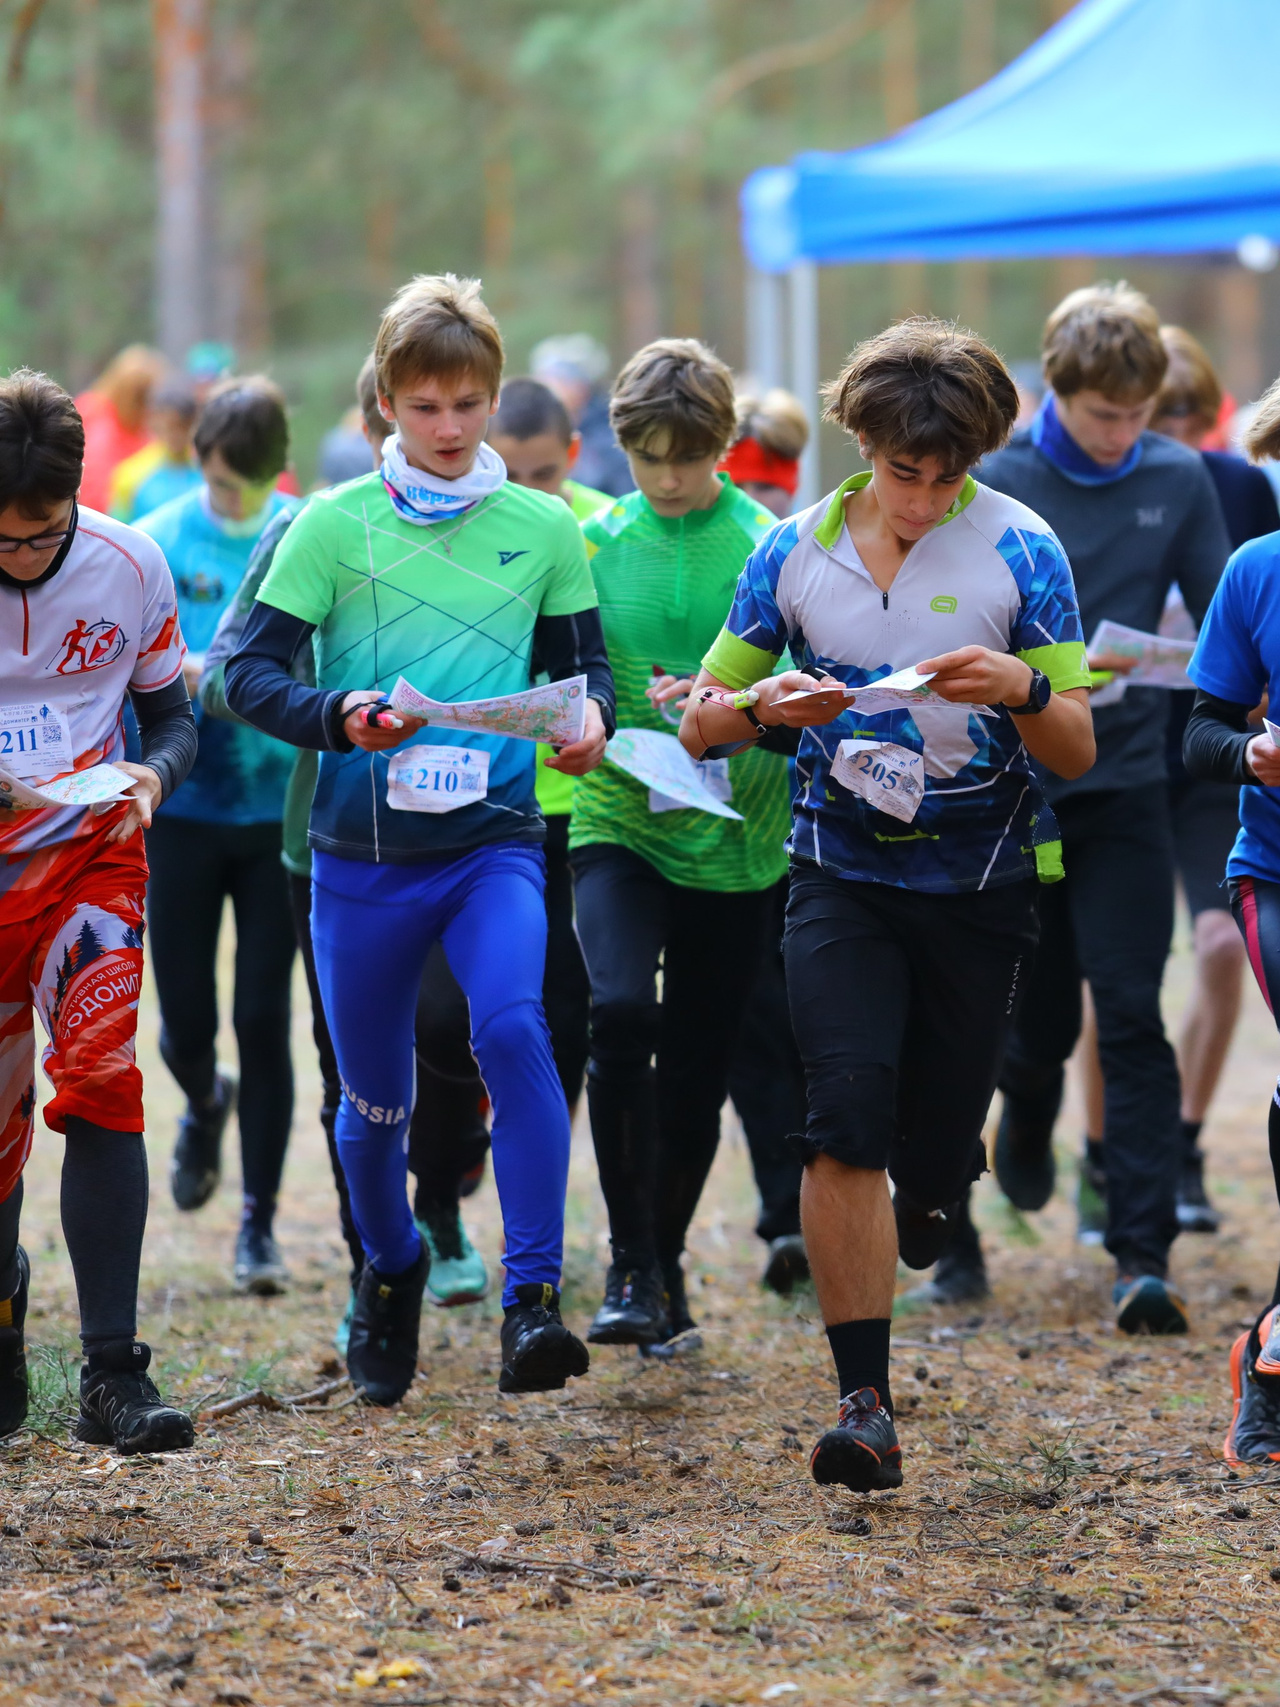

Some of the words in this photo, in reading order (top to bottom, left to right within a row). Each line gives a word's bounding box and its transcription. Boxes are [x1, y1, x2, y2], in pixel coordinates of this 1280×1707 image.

[0, 727, 39, 753] 211
[415, 767, 459, 793] 210
[859, 754, 901, 790] 205
[105, 960, 137, 977] ШКОЛА
[344, 1083, 406, 1125] USSIA
